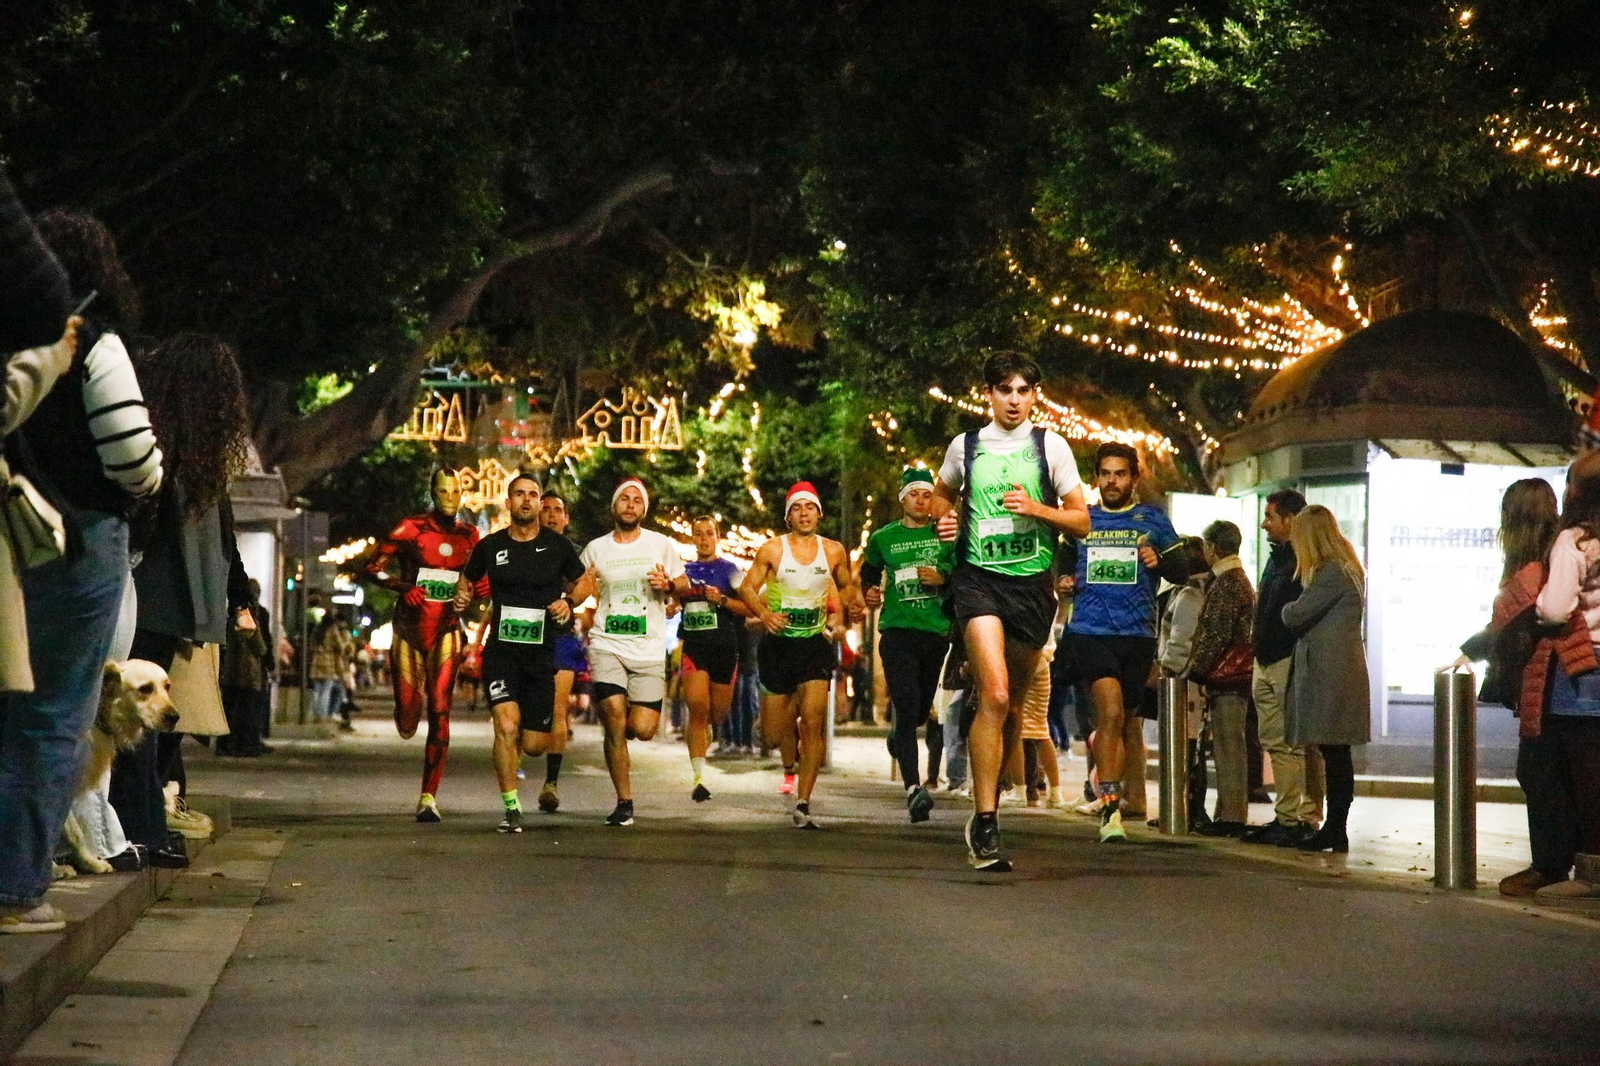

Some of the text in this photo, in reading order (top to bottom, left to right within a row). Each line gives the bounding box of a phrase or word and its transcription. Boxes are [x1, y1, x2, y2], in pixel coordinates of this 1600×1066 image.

[984, 538, 1034, 557] 1159
[1095, 565, 1127, 579] 483
[610, 619, 640, 632] 948
[685, 615, 714, 627] 1962
[502, 624, 539, 638] 1579
